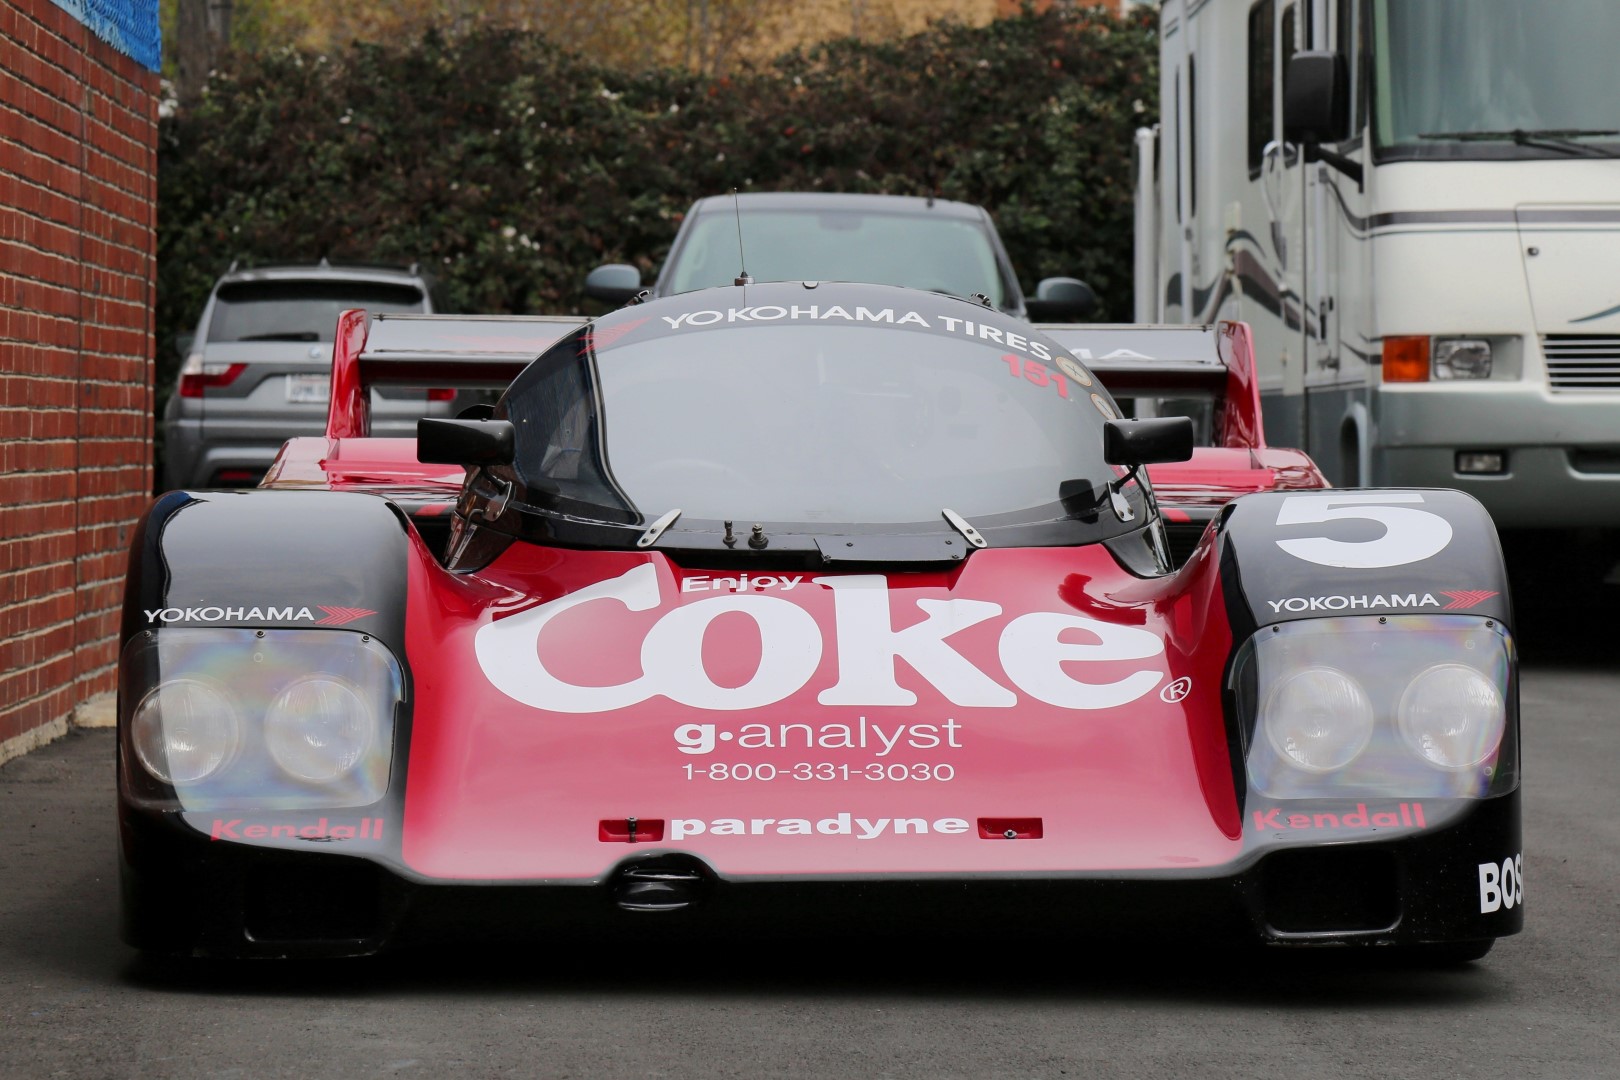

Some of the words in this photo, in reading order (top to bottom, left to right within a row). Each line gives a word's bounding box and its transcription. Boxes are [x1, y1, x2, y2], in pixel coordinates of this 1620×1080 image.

[662, 305, 931, 330] YOKOHAMA
[937, 315, 1052, 362] TIRES
[1001, 353, 1069, 399] 151
[1275, 493, 1453, 569] 5
[681, 573, 804, 593] Enjoy
[144, 606, 315, 623] YOKOHAMA
[1267, 592, 1440, 613] YOKOHAMA
[474, 562, 1164, 713] Coke
[682, 762, 956, 781] 1-800-331-3030
[210, 817, 384, 841] Kendall
[671, 812, 970, 841] paradyne
[1252, 803, 1426, 832] Kendall
[1478, 852, 1524, 914] BOS
